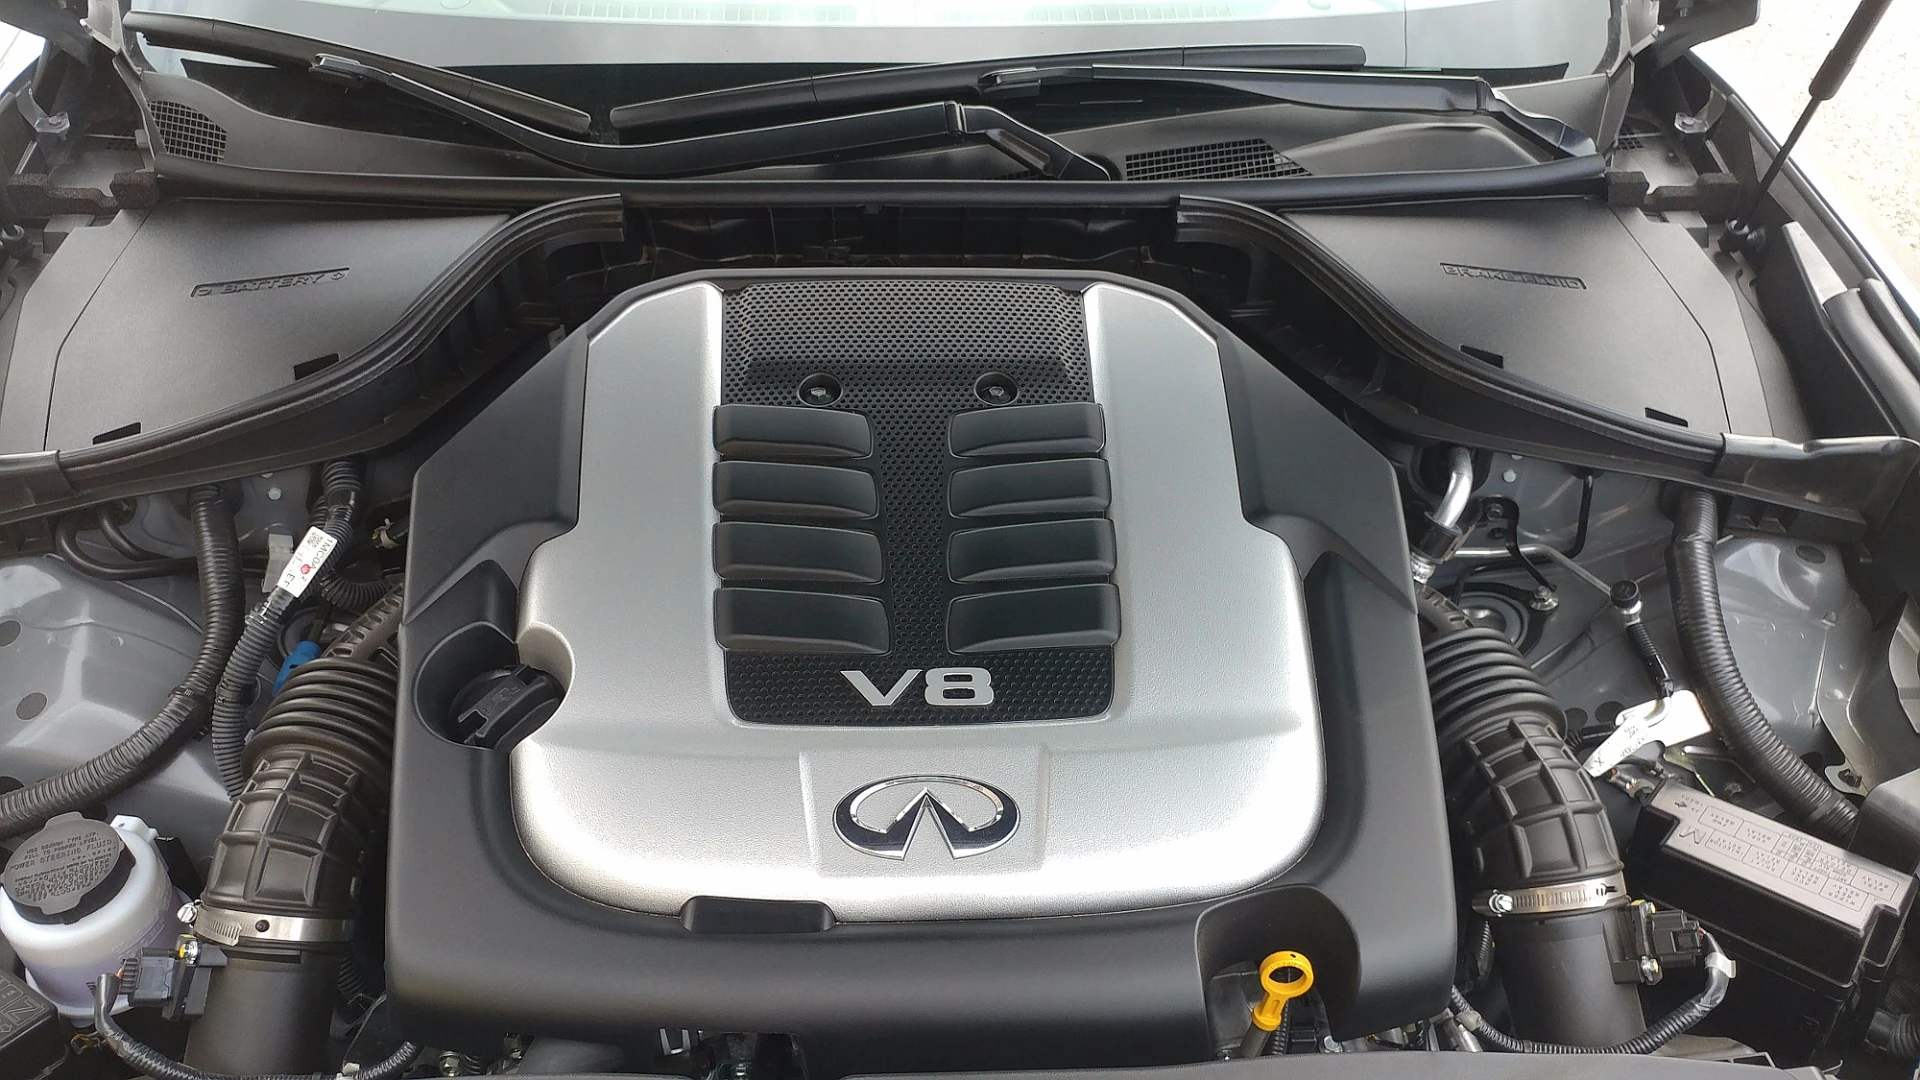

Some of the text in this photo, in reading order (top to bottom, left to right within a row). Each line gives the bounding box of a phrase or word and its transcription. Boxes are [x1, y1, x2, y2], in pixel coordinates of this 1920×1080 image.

[221, 274, 325, 294] BATTERY
[1442, 265, 1580, 289] BRAKE FLUID
[840, 667, 994, 708] V8
[1679, 826, 1706, 845] M
[9, 839, 112, 871] POWER STEERING FLUID
[1832, 882, 1860, 897] RELAY
[1862, 875, 1889, 889] RELAY
[1827, 891, 1856, 906] WIPER
